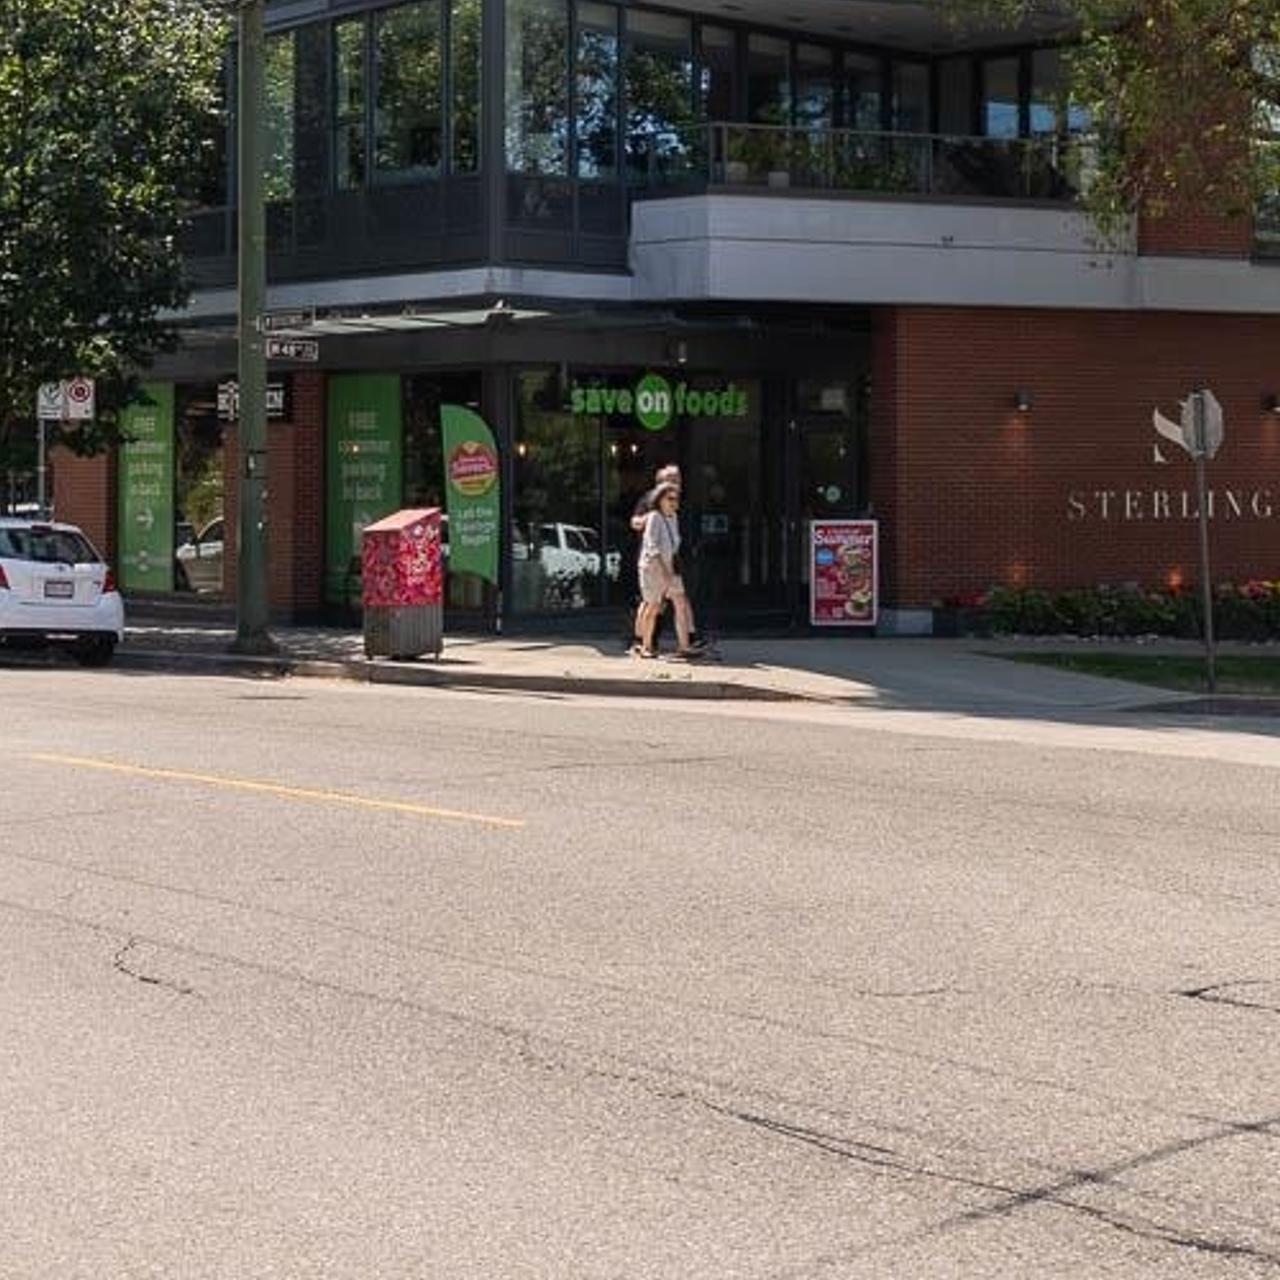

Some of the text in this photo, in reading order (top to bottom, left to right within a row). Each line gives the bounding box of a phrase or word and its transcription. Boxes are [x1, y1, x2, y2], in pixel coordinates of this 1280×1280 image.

[571, 381, 748, 416] save on foods
[1069, 490, 1272, 519] STERLING
